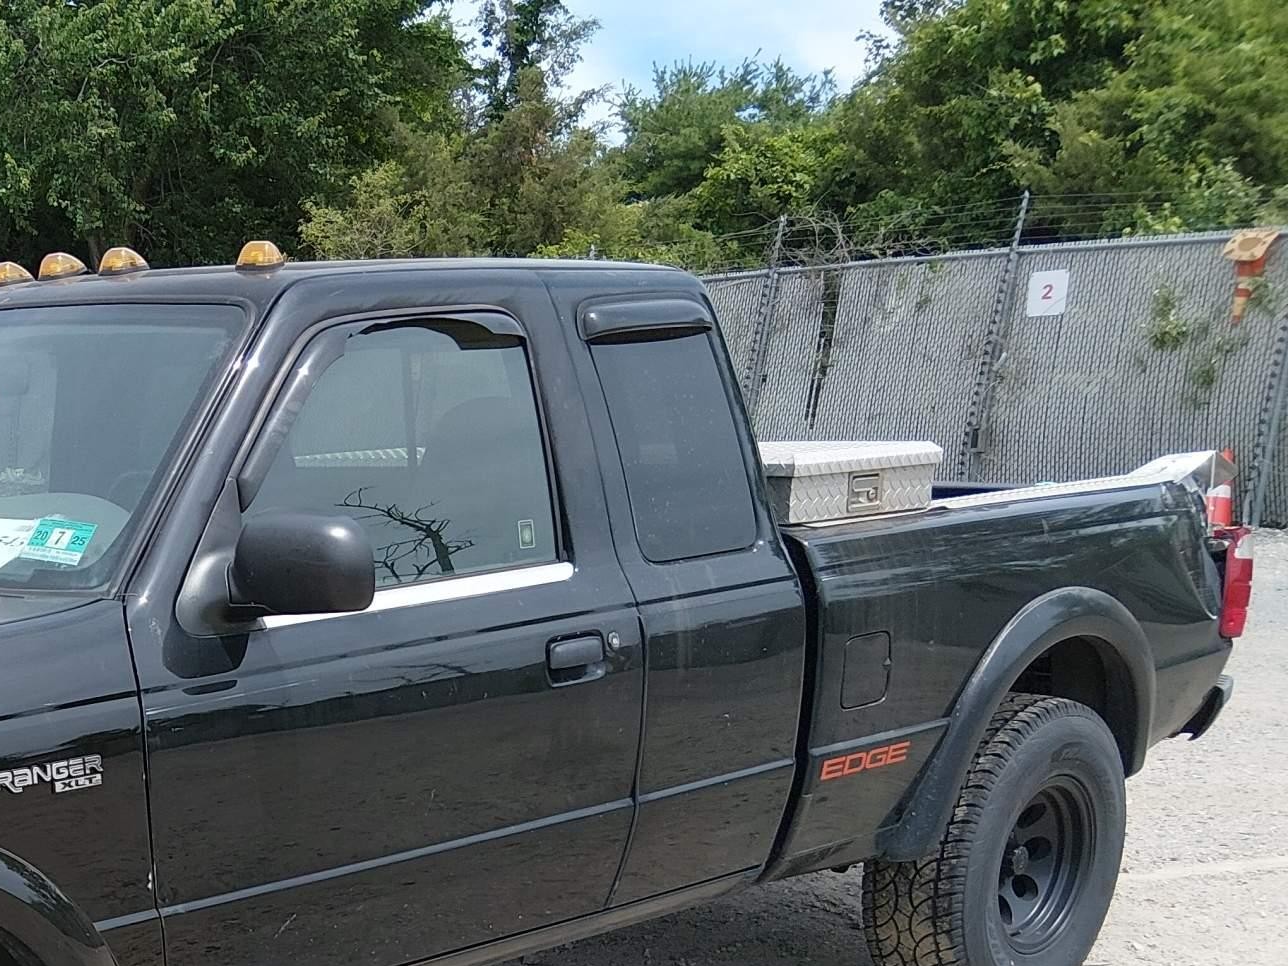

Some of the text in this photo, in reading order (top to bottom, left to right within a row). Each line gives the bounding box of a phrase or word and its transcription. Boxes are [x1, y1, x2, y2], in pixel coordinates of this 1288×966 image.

[1040, 284, 1054, 300] 2
[33, 530, 88, 546] 20 7 25
[820, 740, 911, 781] EDGE
